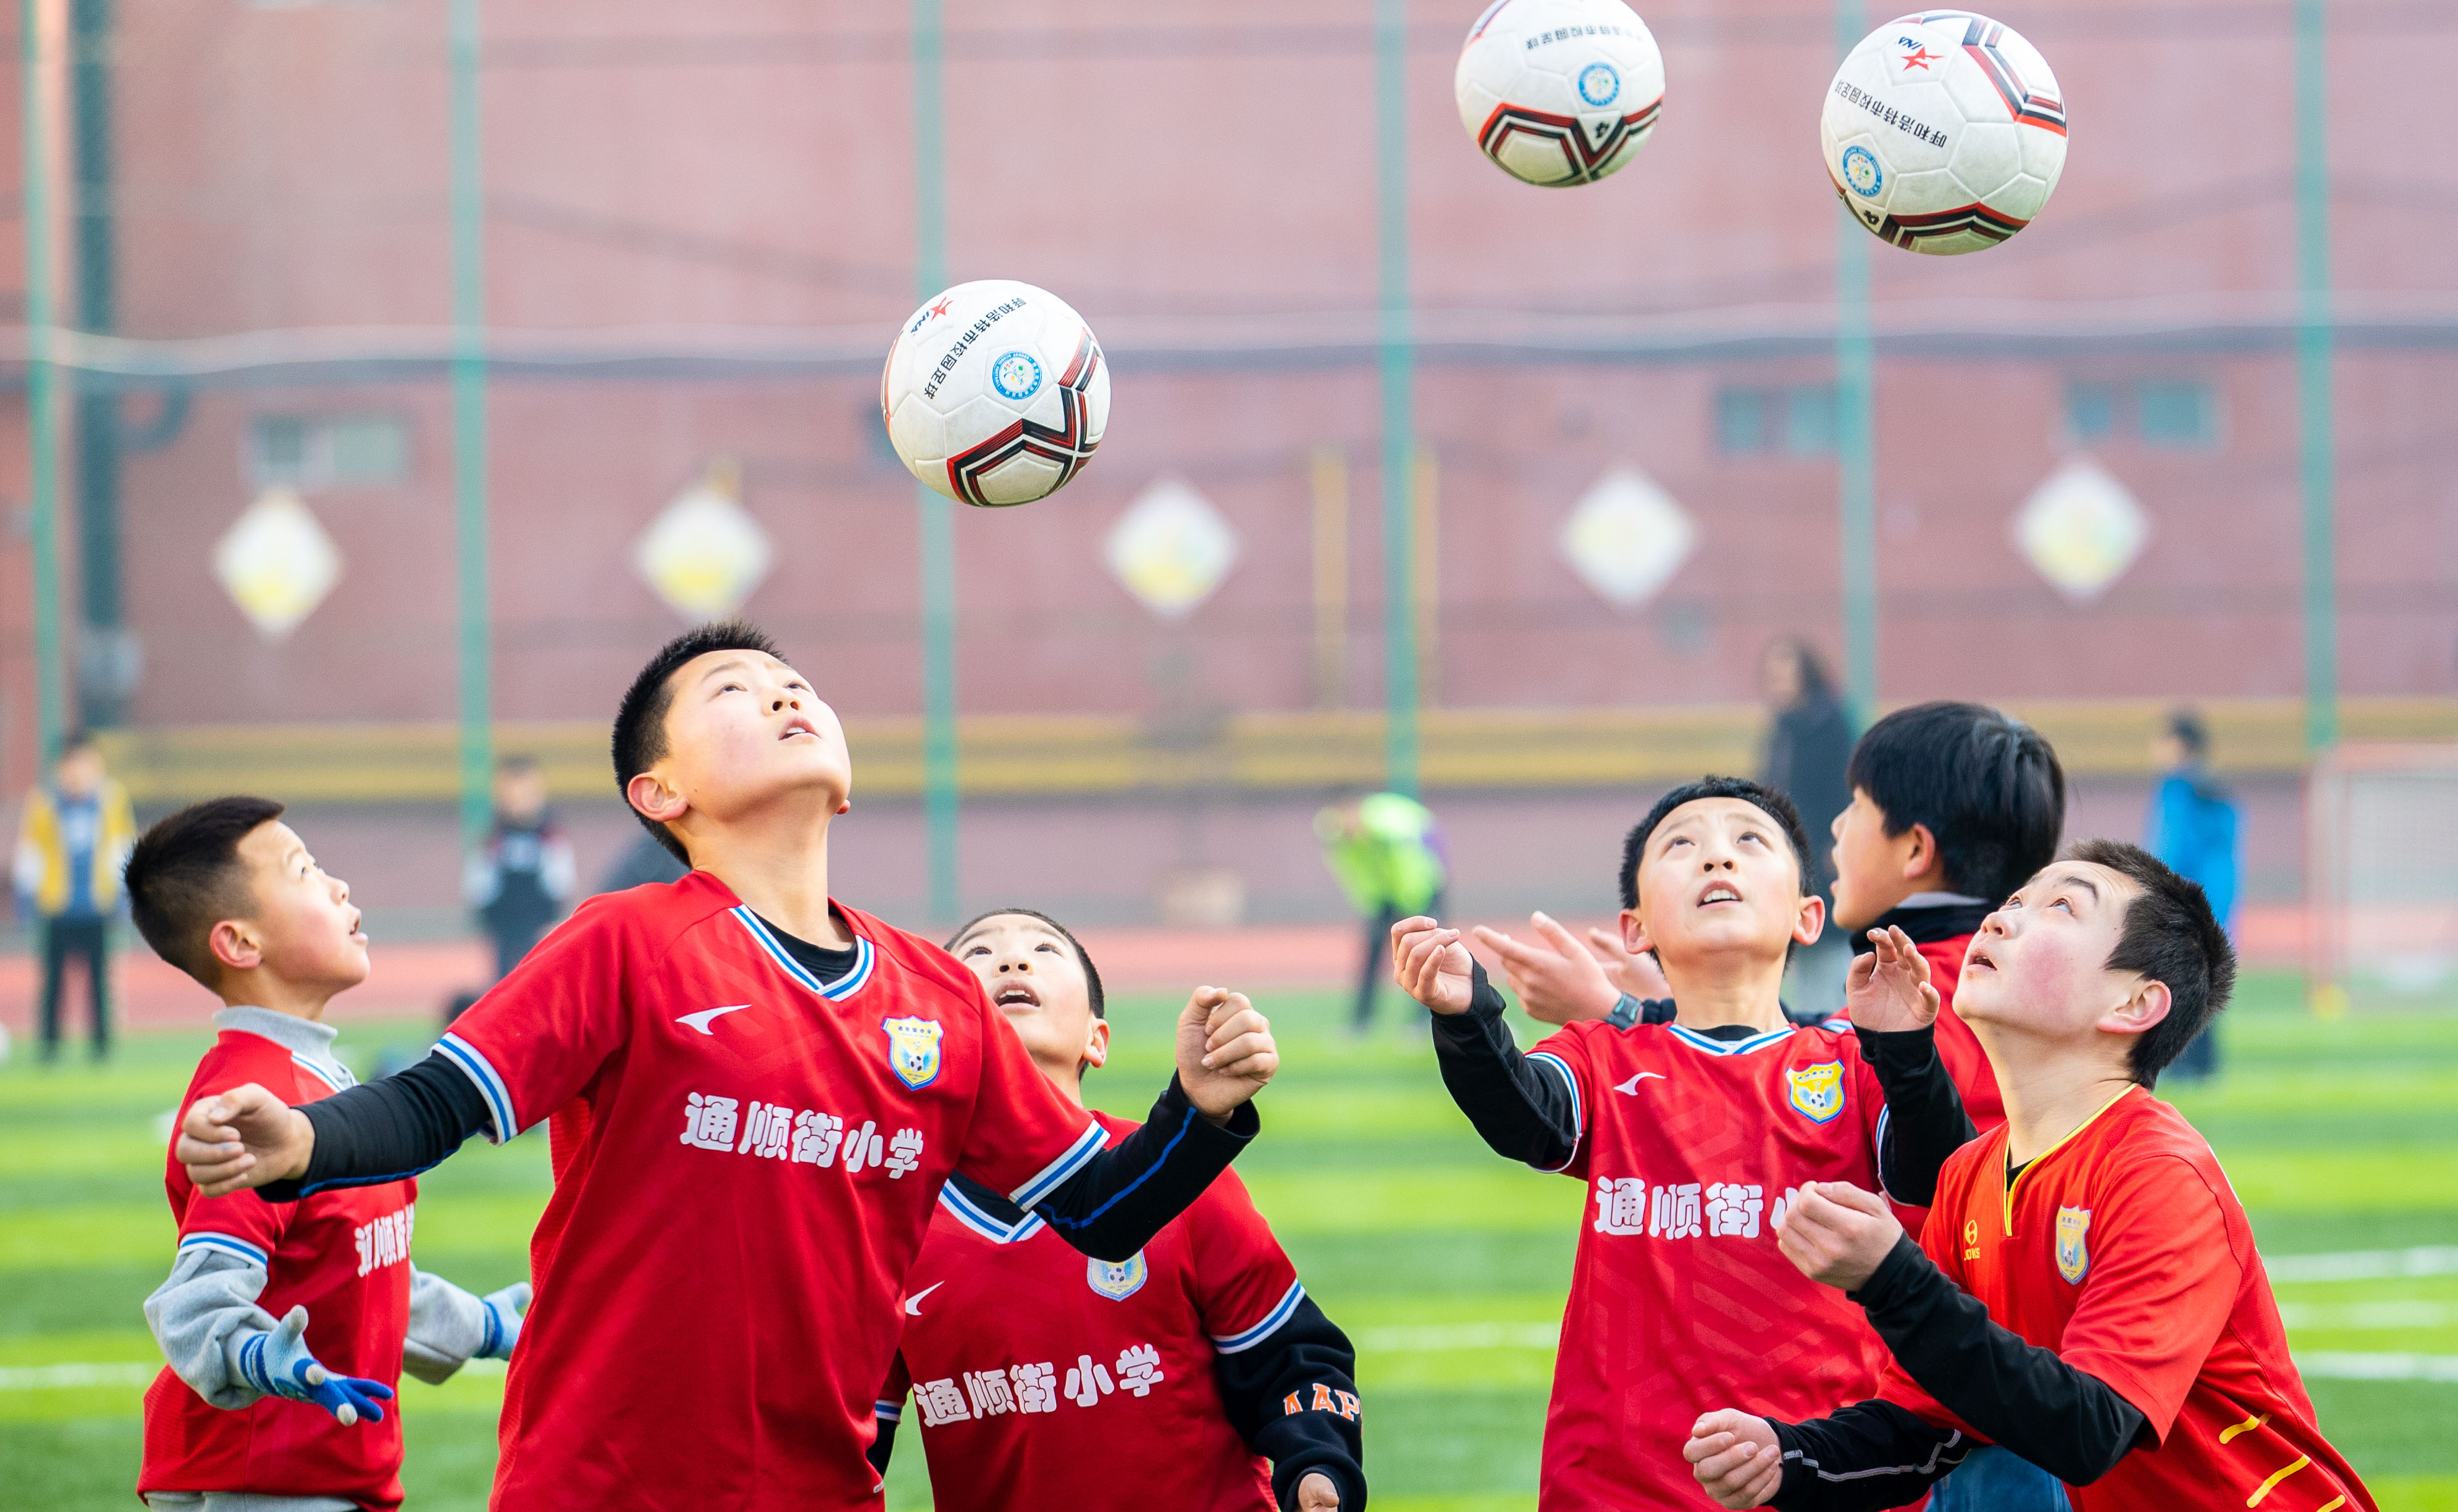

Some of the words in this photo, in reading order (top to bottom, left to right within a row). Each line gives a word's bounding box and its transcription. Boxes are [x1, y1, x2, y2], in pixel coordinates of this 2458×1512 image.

[924, 297, 1026, 399] 呼和浩特市校园足球
[679, 1092, 924, 1179] 通顺街小学
[913, 1343, 1164, 1427] 通顺街小学
[1283, 1383, 1362, 1422] AAP
